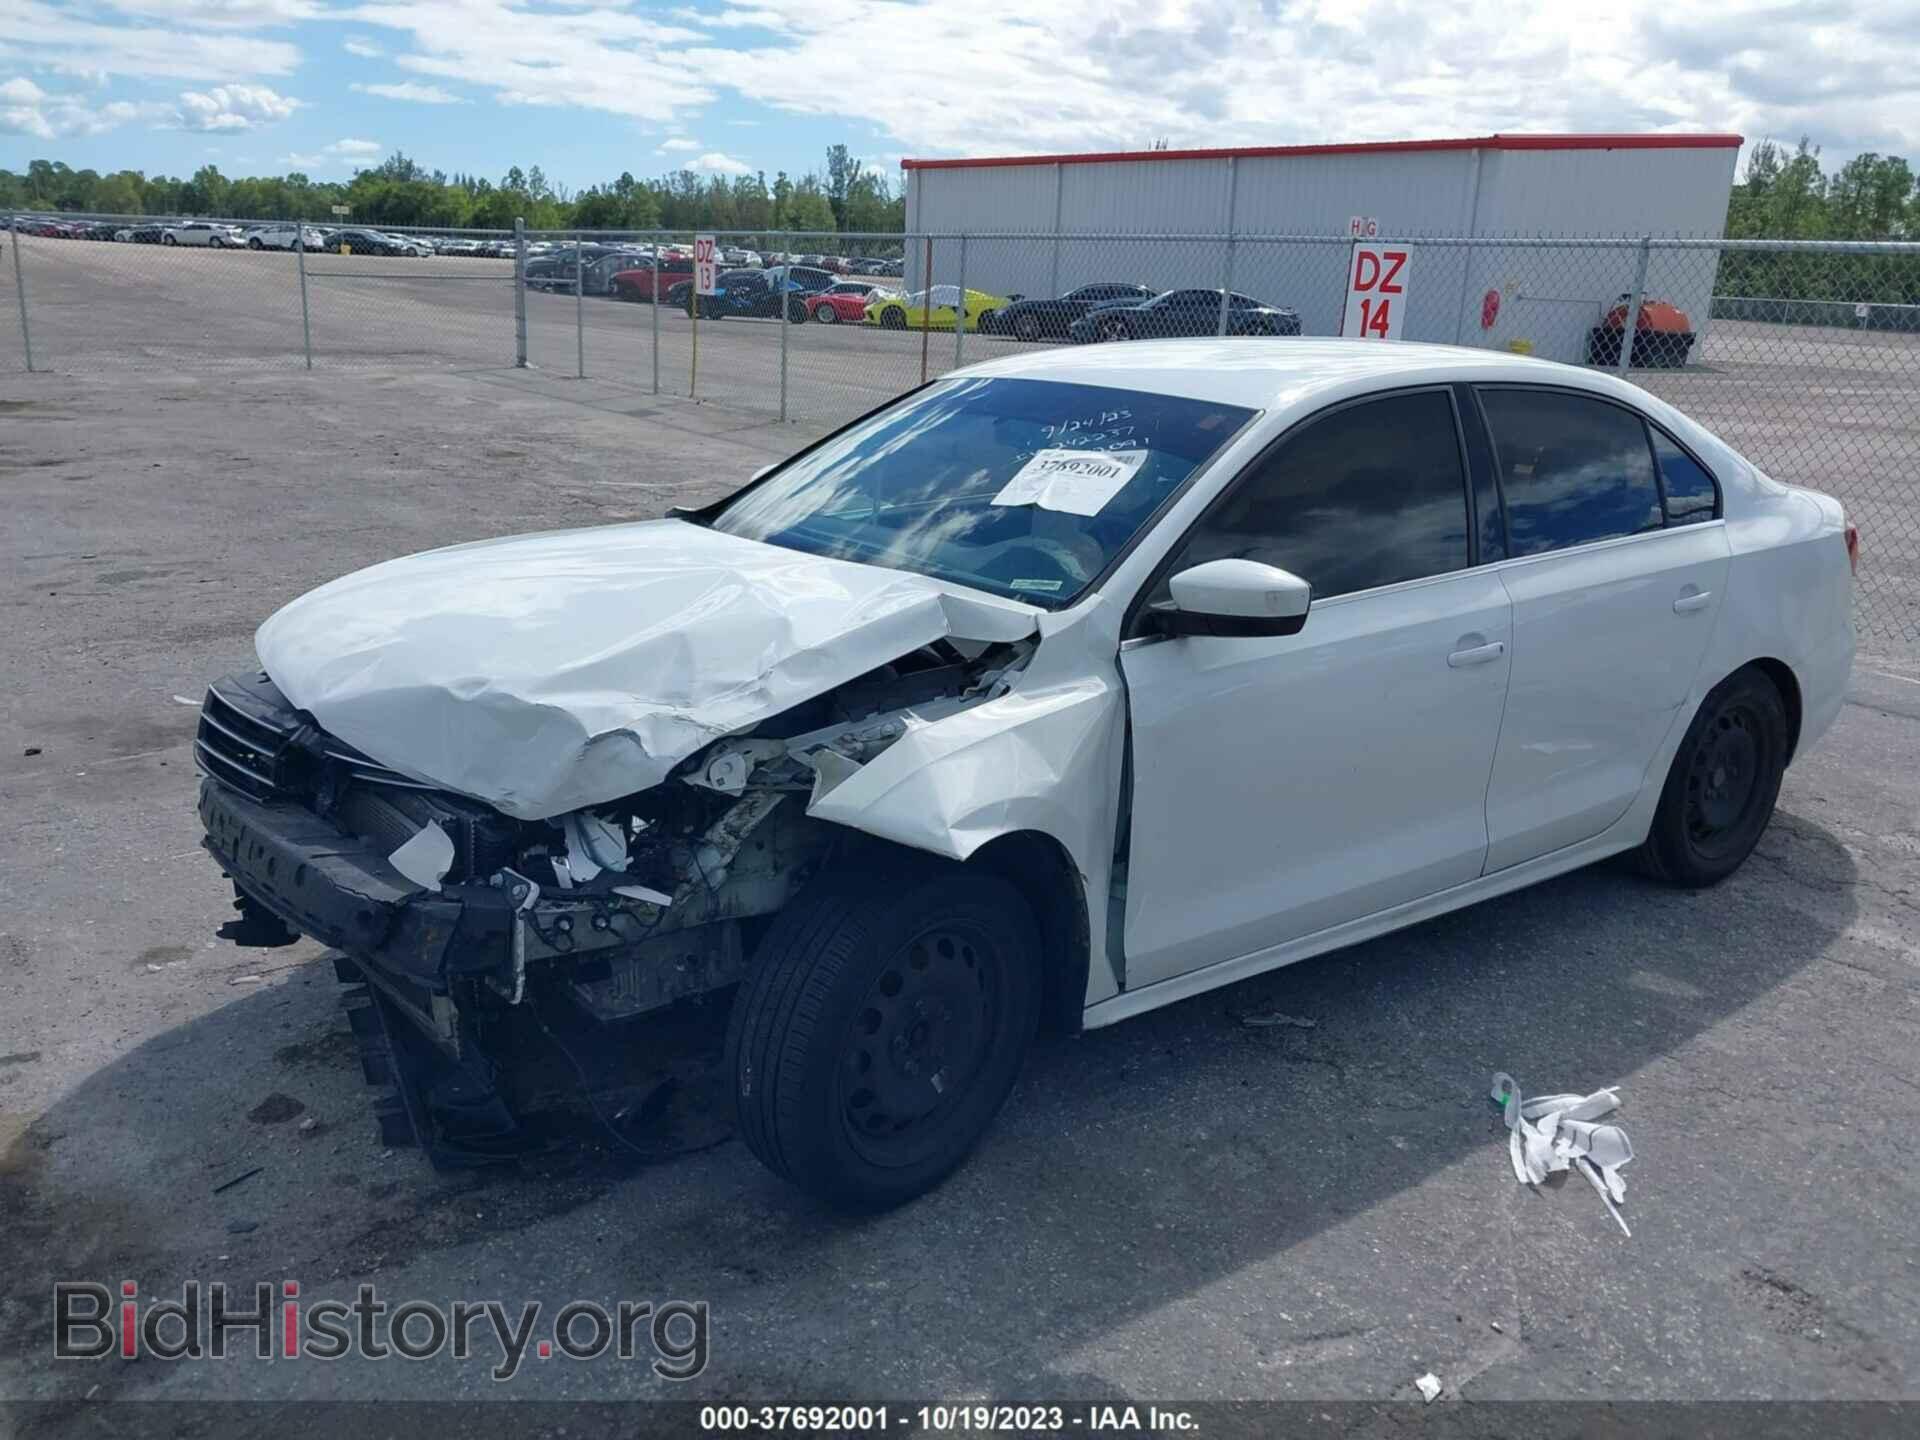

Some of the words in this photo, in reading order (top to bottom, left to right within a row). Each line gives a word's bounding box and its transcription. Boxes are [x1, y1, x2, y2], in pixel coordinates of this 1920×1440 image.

[697, 240, 713, 263] DZ
[701, 267, 711, 289] 13
[1353, 251, 1407, 293] DZ
[1359, 298, 1390, 338] 14
[1034, 459, 1121, 479] 37692001
